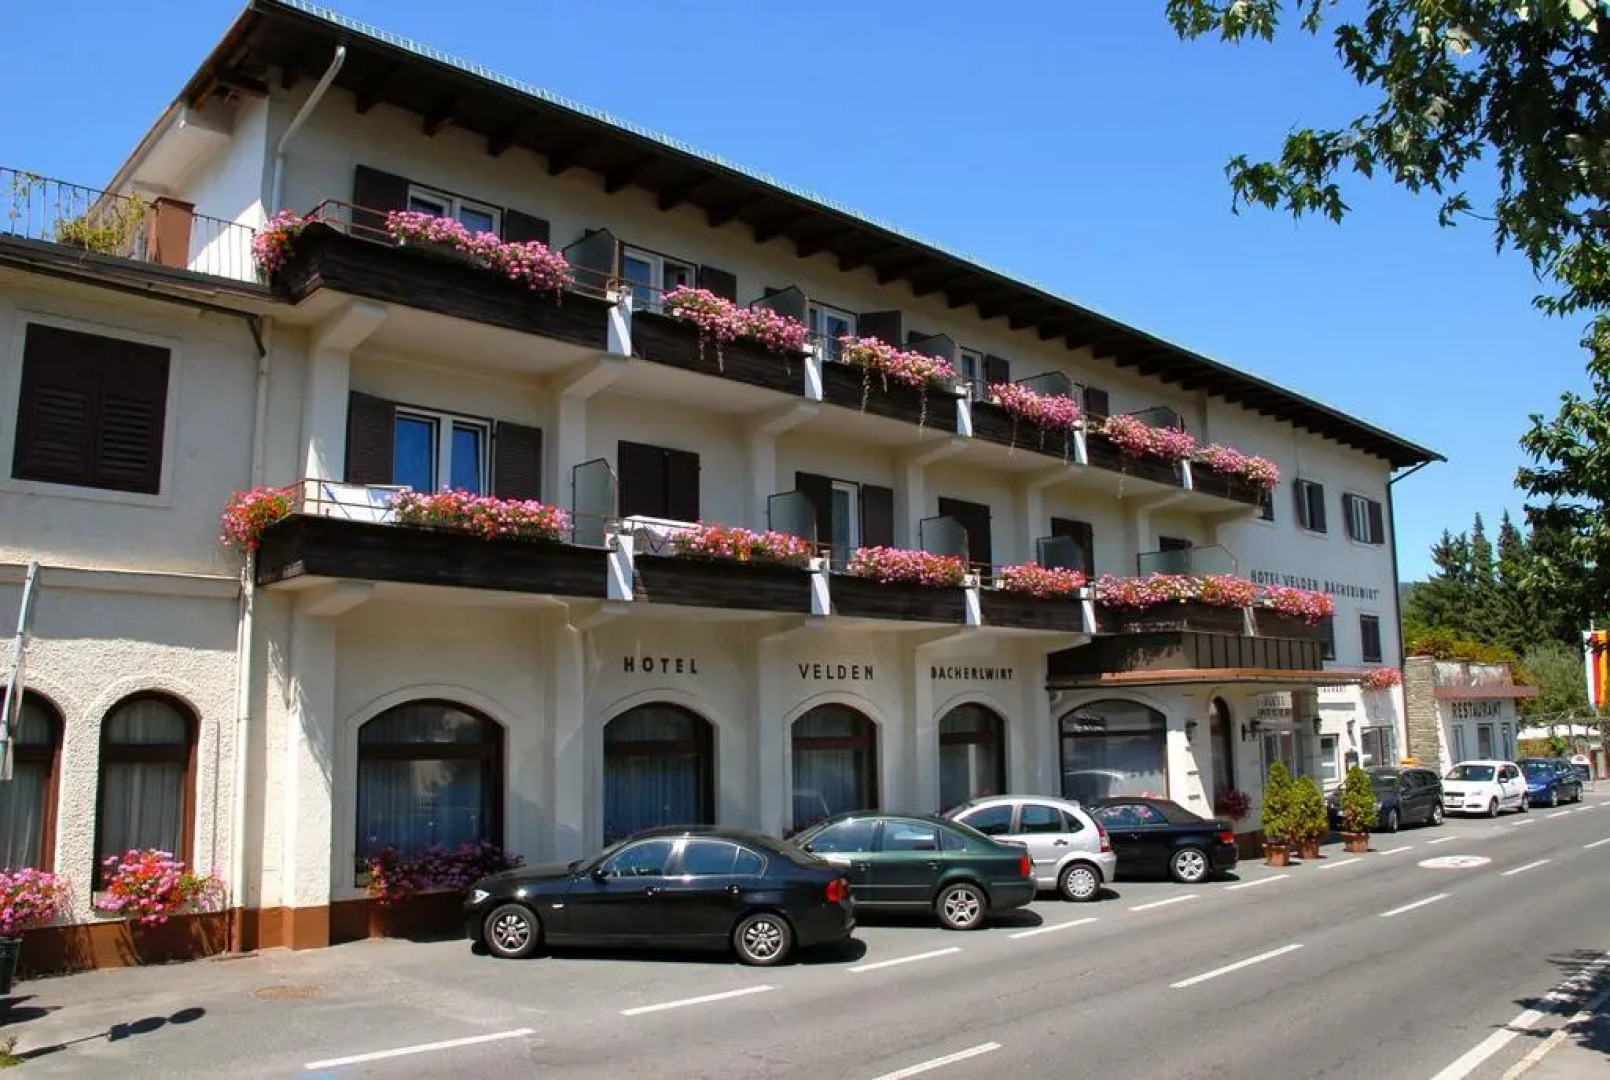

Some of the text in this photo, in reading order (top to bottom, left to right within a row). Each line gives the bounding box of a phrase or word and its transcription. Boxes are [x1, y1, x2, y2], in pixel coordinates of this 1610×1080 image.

[1251, 569, 1279, 585] HOTEL
[624, 656, 1014, 680] HOTEL VELDEN BACHERLWIRT
[1451, 701, 1501, 718] RESTAURANT
